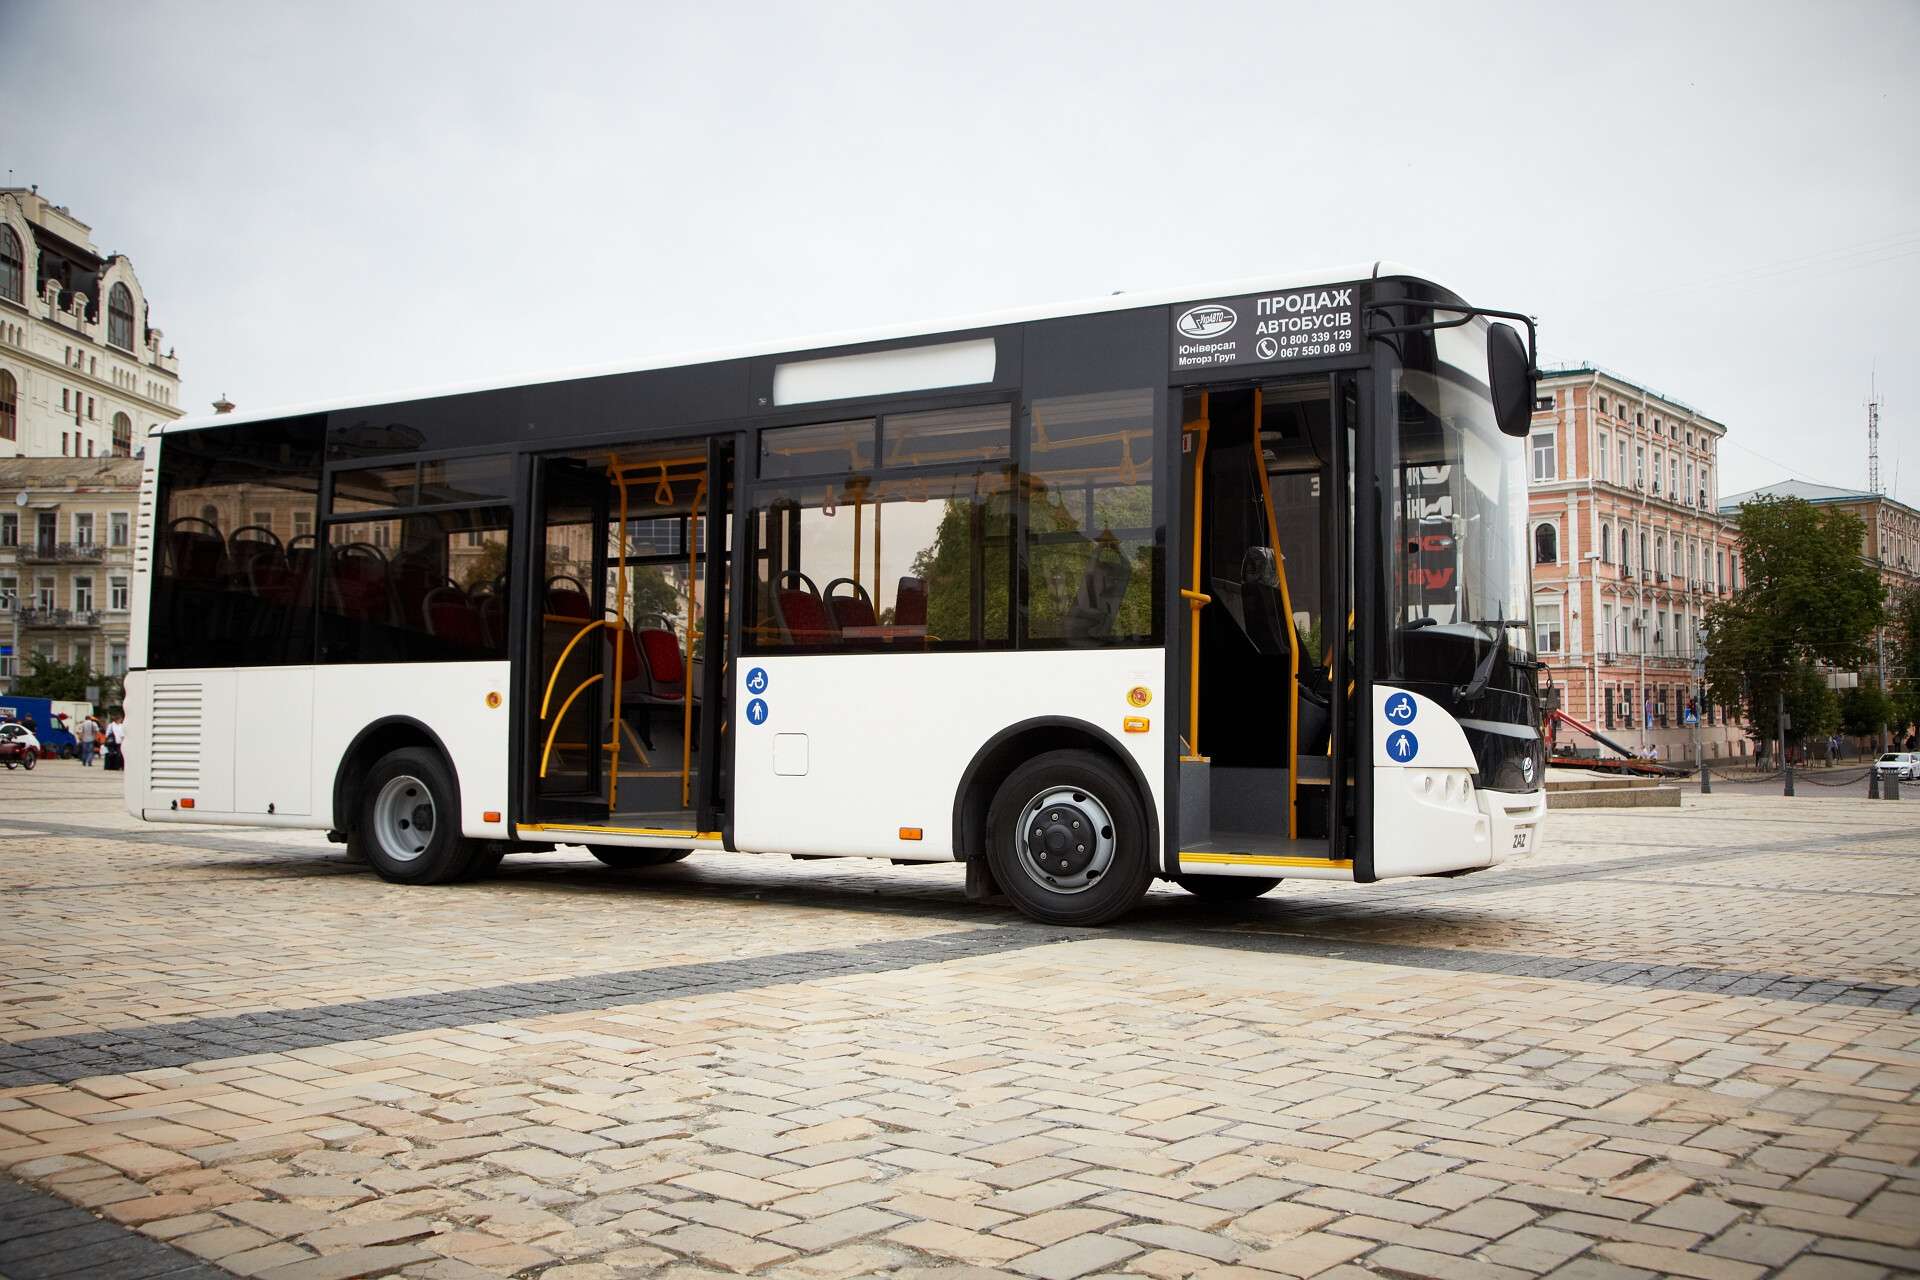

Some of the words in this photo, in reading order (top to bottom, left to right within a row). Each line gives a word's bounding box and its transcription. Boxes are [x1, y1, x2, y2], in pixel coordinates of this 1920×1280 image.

[1257, 289, 1352, 316] ПРОДАЖ
[1256, 312, 1352, 335] АВТОБУСІВ
[1281, 336, 1287, 346] 0
[1290, 334, 1308, 345] 800
[1311, 332, 1330, 343] 339
[1333, 330, 1352, 340] 129
[1179, 342, 1236, 354] Юніверсал
[1281, 347, 1298, 357] 067
[1302, 346, 1320, 356] 550
[1323, 344, 1336, 354] 08
[1339, 342, 1352, 352] 09
[1214, 353, 1236, 363] Груп
[1513, 834, 1526, 848] ZAZ
